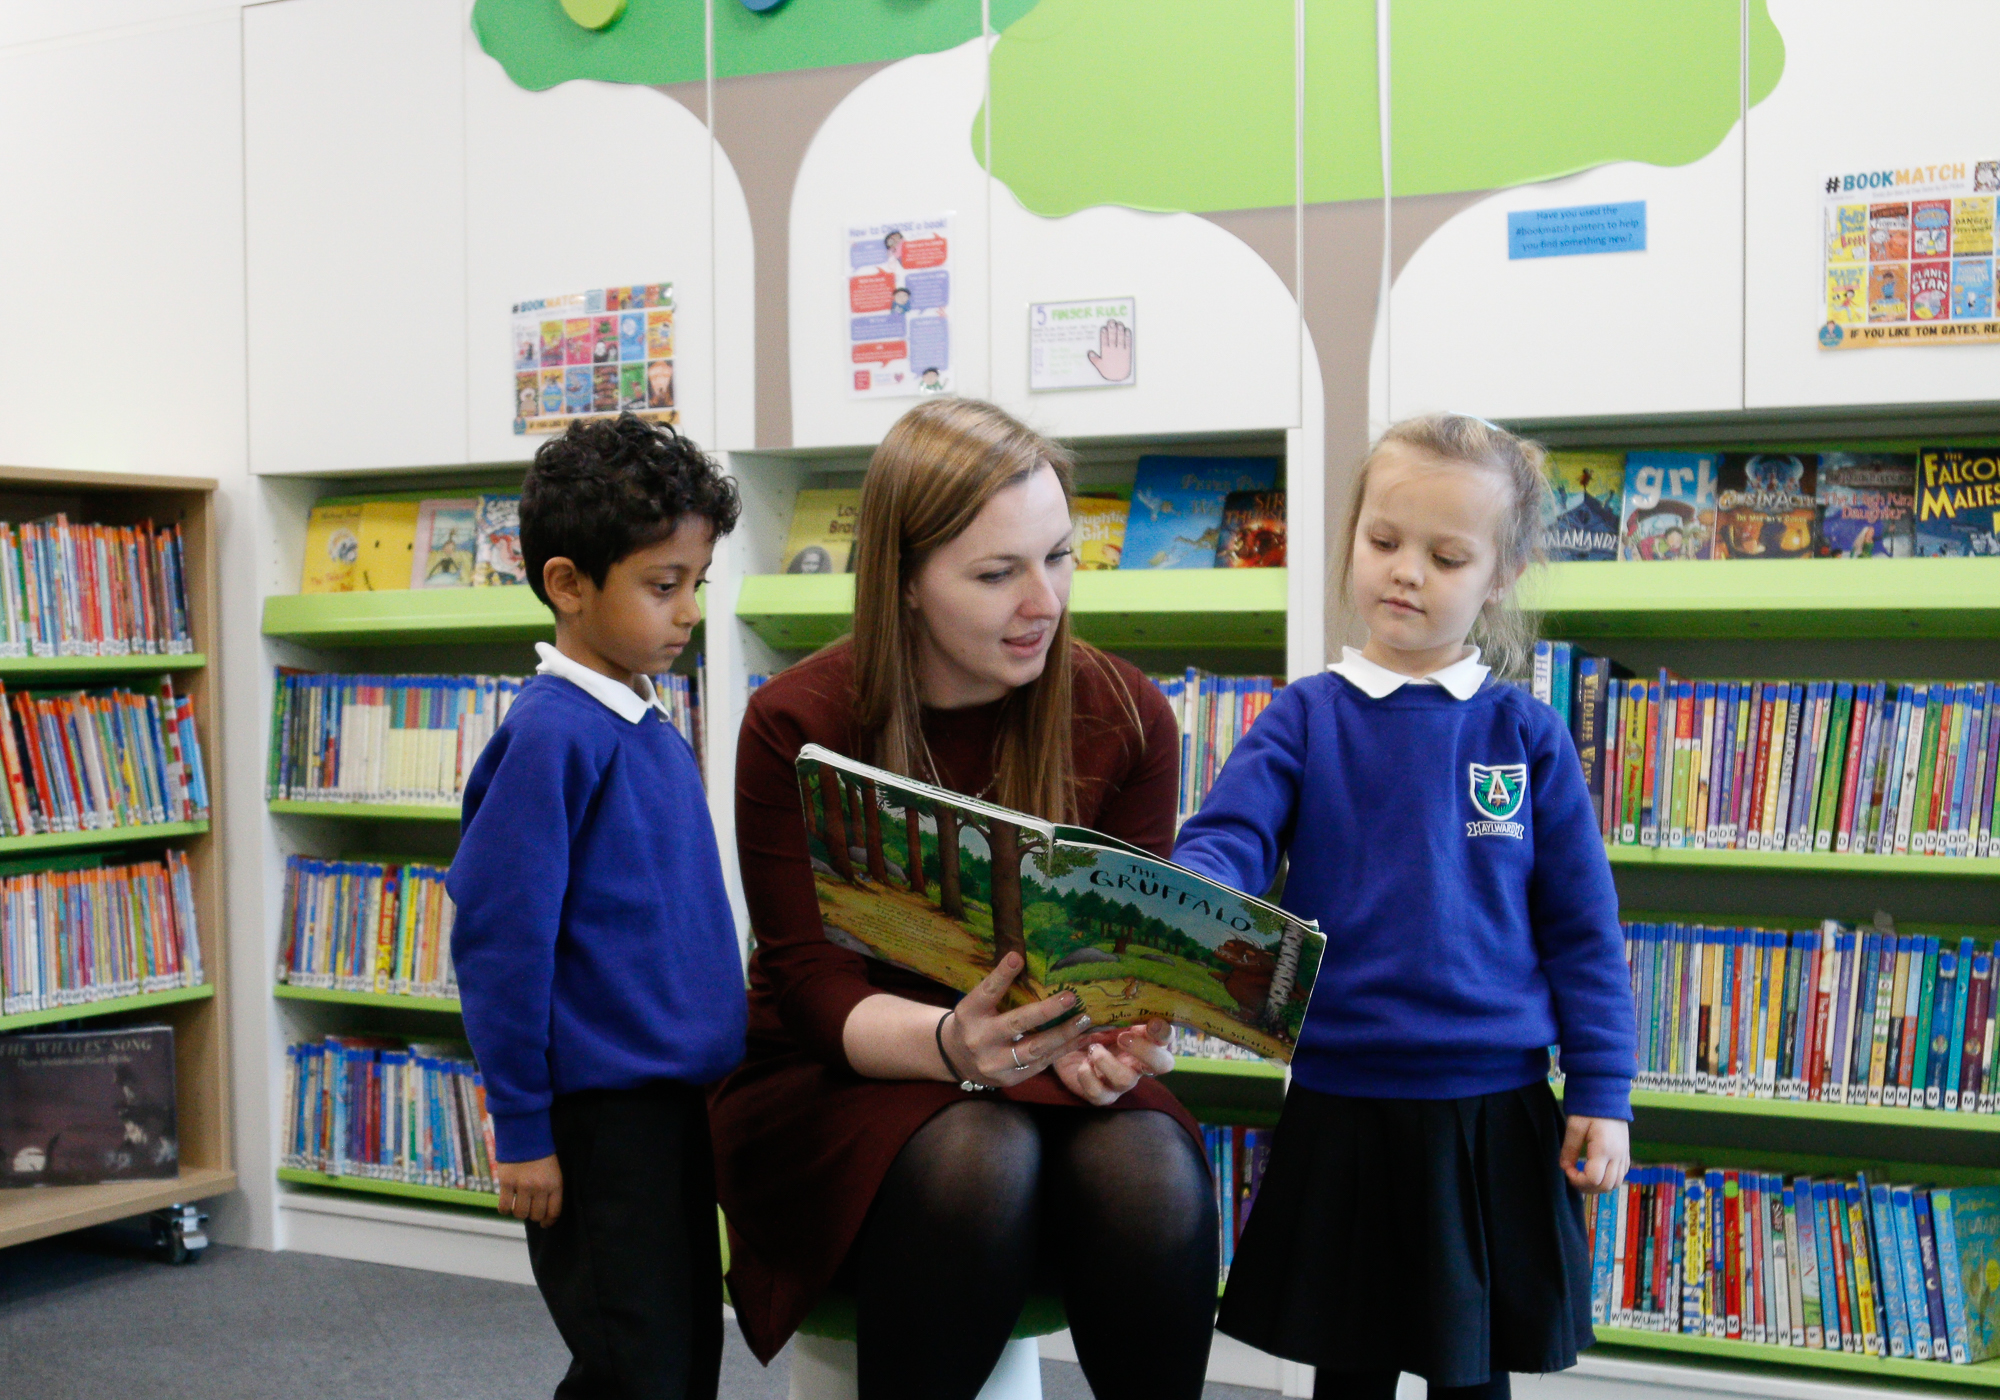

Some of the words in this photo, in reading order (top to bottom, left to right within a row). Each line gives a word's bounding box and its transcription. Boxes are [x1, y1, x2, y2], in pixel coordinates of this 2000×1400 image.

[1826, 163, 1965, 194] #BOOKMATCH
[1536, 210, 1558, 220] Have
[1560, 211, 1577, 220] you
[1580, 207, 1600, 217] used
[1602, 205, 1618, 215] the
[1516, 224, 1570, 236] #bookmatch
[1573, 222, 1605, 233] posters
[1607, 221, 1618, 229] to
[1619, 219, 1639, 229] help
[1522, 242, 1539, 251] you
[1541, 240, 1558, 249] find
[1560, 235, 1607, 246] something
[1608, 233, 1633, 243] new?
[1912, 278, 1948, 295] STAN
[512, 292, 586, 314] #BOOKMATC
[1036, 305, 1047, 326] 5
[1851, 329, 1859, 339] IF
[1864, 328, 1885, 338] YOU
[1888, 327, 1910, 337] LIKE
[1916, 326, 1937, 336] TOM
[1984, 323, 2000, 333] RE
[1944, 453, 1963, 461] THE
[1582, 674, 1600, 743] WILDLIFE
[1789, 703, 1801, 735] WILD
[1488, 770, 1510, 805] A
[1482, 823, 1516, 833] AYLWARD
[1730, 828, 1737, 837] D
[1625, 829, 1633, 838] D
[1673, 832, 1680, 841] D
[1709, 829, 1717, 838] D
[1720, 829, 1727, 838] D
[1776, 832, 1784, 840] D
[1898, 834, 1906, 842] D
[1959, 834, 1966, 842] D
[1980, 834, 1988, 842] D
[1697, 834, 1704, 844] D
[1750, 835, 1757, 844] D
[1820, 835, 1827, 843] D
[1839, 837, 1846, 845] D
[1915, 838, 1922, 846] D
[1928, 836, 1936, 844] D
[1939, 838, 1946, 846] D
[1949, 835, 1957, 843] D
[1883, 840, 1891, 848] D
[1991, 843, 1999, 852] D
[1128, 864, 1159, 879] THE
[1089, 870, 1251, 932] GRUFFALO
[1138, 1008, 1192, 1022] Donaldson
[1231, 1030, 1276, 1055] Scheffler
[1638, 1075, 1647, 1084] M
[1698, 1077, 1706, 1085] M
[1709, 1080, 1716, 1088] M
[1728, 1080, 1736, 1088] M
[1719, 1082, 1727, 1090] M
[1764, 1083, 1772, 1091] M
[1781, 1083, 1790, 1092] M
[1857, 1090, 1866, 1098] M
[1870, 1091, 1878, 1099] M
[1886, 1091, 1894, 1099] M
[1899, 1091, 1907, 1099] M
[1913, 1093, 1922, 1101] M
[1929, 1091, 1937, 1100] M
[1947, 1096, 1955, 1104] M
[1964, 1097, 1972, 1105] M
[1595, 1303, 1603, 1312] W
[1612, 1312, 1620, 1321] W
[1623, 1312, 1631, 1321] W
[1633, 1314, 1641, 1323] W
[1716, 1320, 1724, 1330] W
[1730, 1319, 1738, 1328] M
[1780, 1330, 1788, 1339] W
[1829, 1335, 1837, 1343] W
[1867, 1337, 1875, 1346] W
[1893, 1340, 1901, 1349] W
[1919, 1344, 1927, 1353] W
[1936, 1342, 1945, 1351] W
[1955, 1349, 1963, 1358] W
